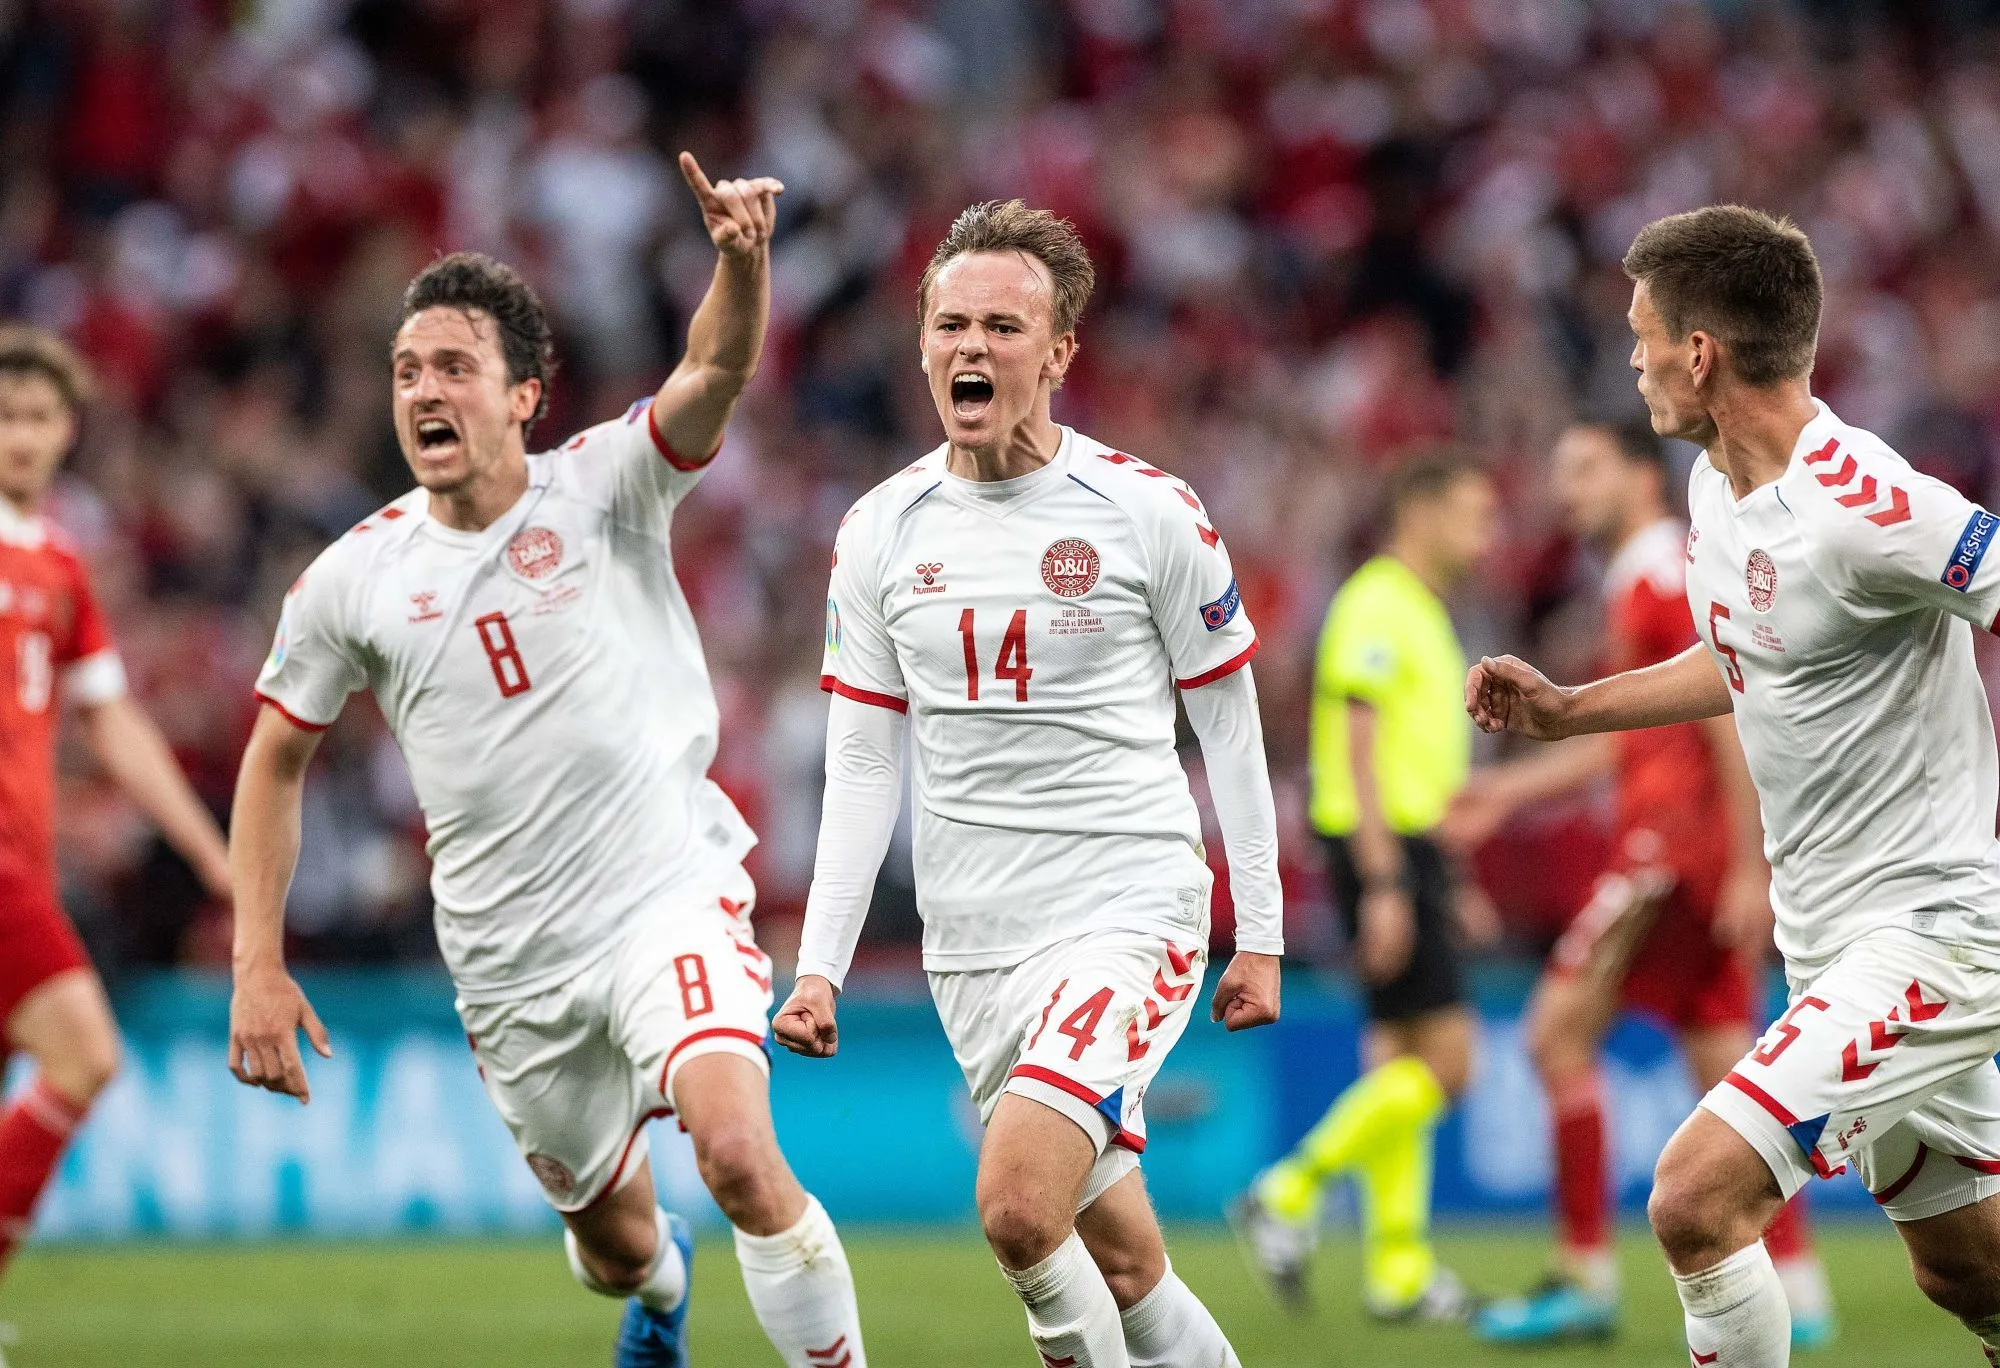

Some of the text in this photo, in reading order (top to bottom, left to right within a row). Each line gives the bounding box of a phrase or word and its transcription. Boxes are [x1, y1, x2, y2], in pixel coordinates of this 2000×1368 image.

[1958, 513, 1994, 567] RESPECT
[1042, 555, 1058, 590] DANSK
[1052, 557, 1089, 577] DBU
[1085, 556, 1100, 589] UNION
[1752, 569, 1771, 592] DBU
[912, 583, 946, 595] hummel
[1058, 588, 1084, 598] 1889
[1062, 609, 1091, 617] EURO 2020
[1077, 617, 1102, 626] DENMARK
[475, 610, 532, 699] 8
[957, 608, 1034, 702] 14
[1709, 600, 1745, 694] 5
[673, 953, 714, 1020] 8
[1027, 978, 1115, 1062] 14
[1751, 995, 1831, 1067] 5
